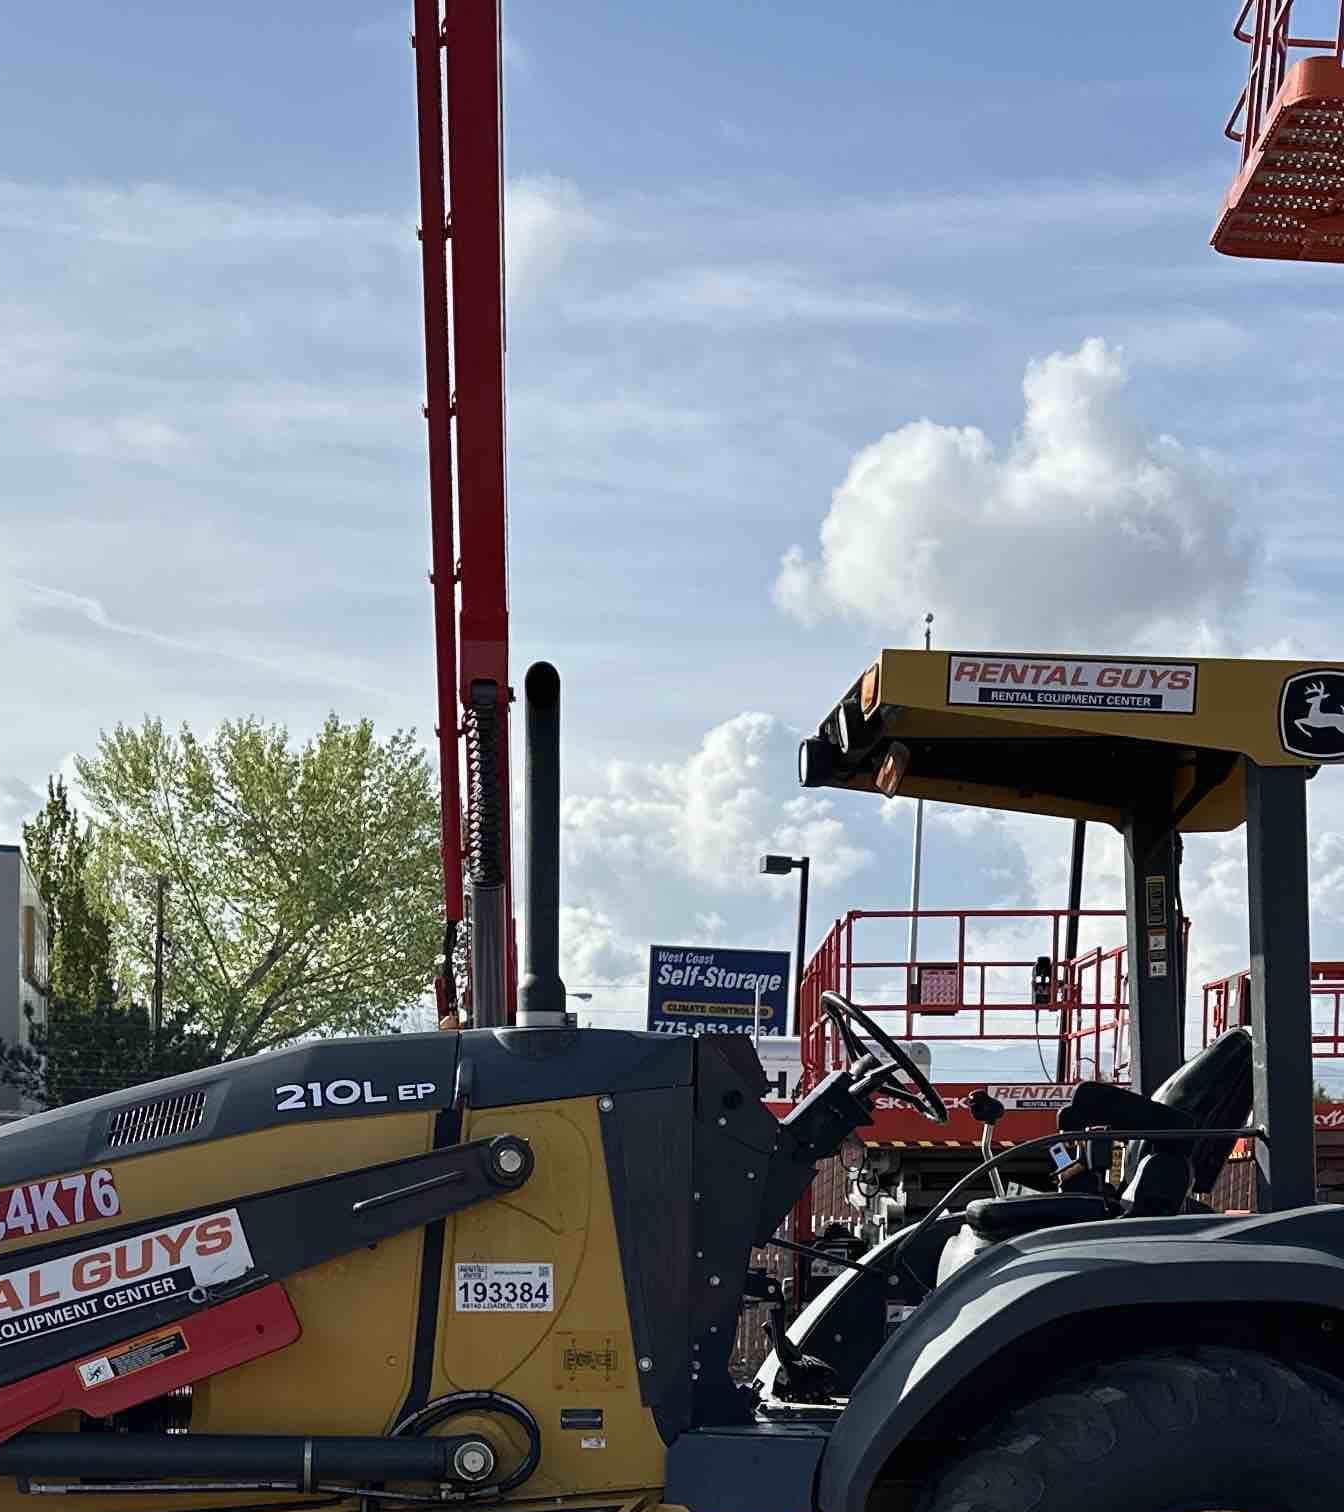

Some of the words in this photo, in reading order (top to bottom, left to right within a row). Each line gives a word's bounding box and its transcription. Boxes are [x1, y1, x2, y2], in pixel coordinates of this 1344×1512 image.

[954, 661, 1089, 688] RENTAL
[1095, 666, 1193, 690] GUYS
[990, 690, 1034, 703] RENTAL
[1036, 692, 1104, 706] EQUIPMENT
[1106, 694, 1152, 707] CENTER
[658, 951, 684, 963] West
[685, 952, 715, 965] Coast
[657, 963, 783, 994] Self-Storage
[708, 1005, 769, 1017] CONTROLLD
[275, 1079, 388, 1111] 210L
[397, 1082, 437, 1101] EP
[71, 1215, 233, 1293] GUYS
[102, 1276, 177, 1319] CENTER
[458, 1281, 550, 1303] 193384
